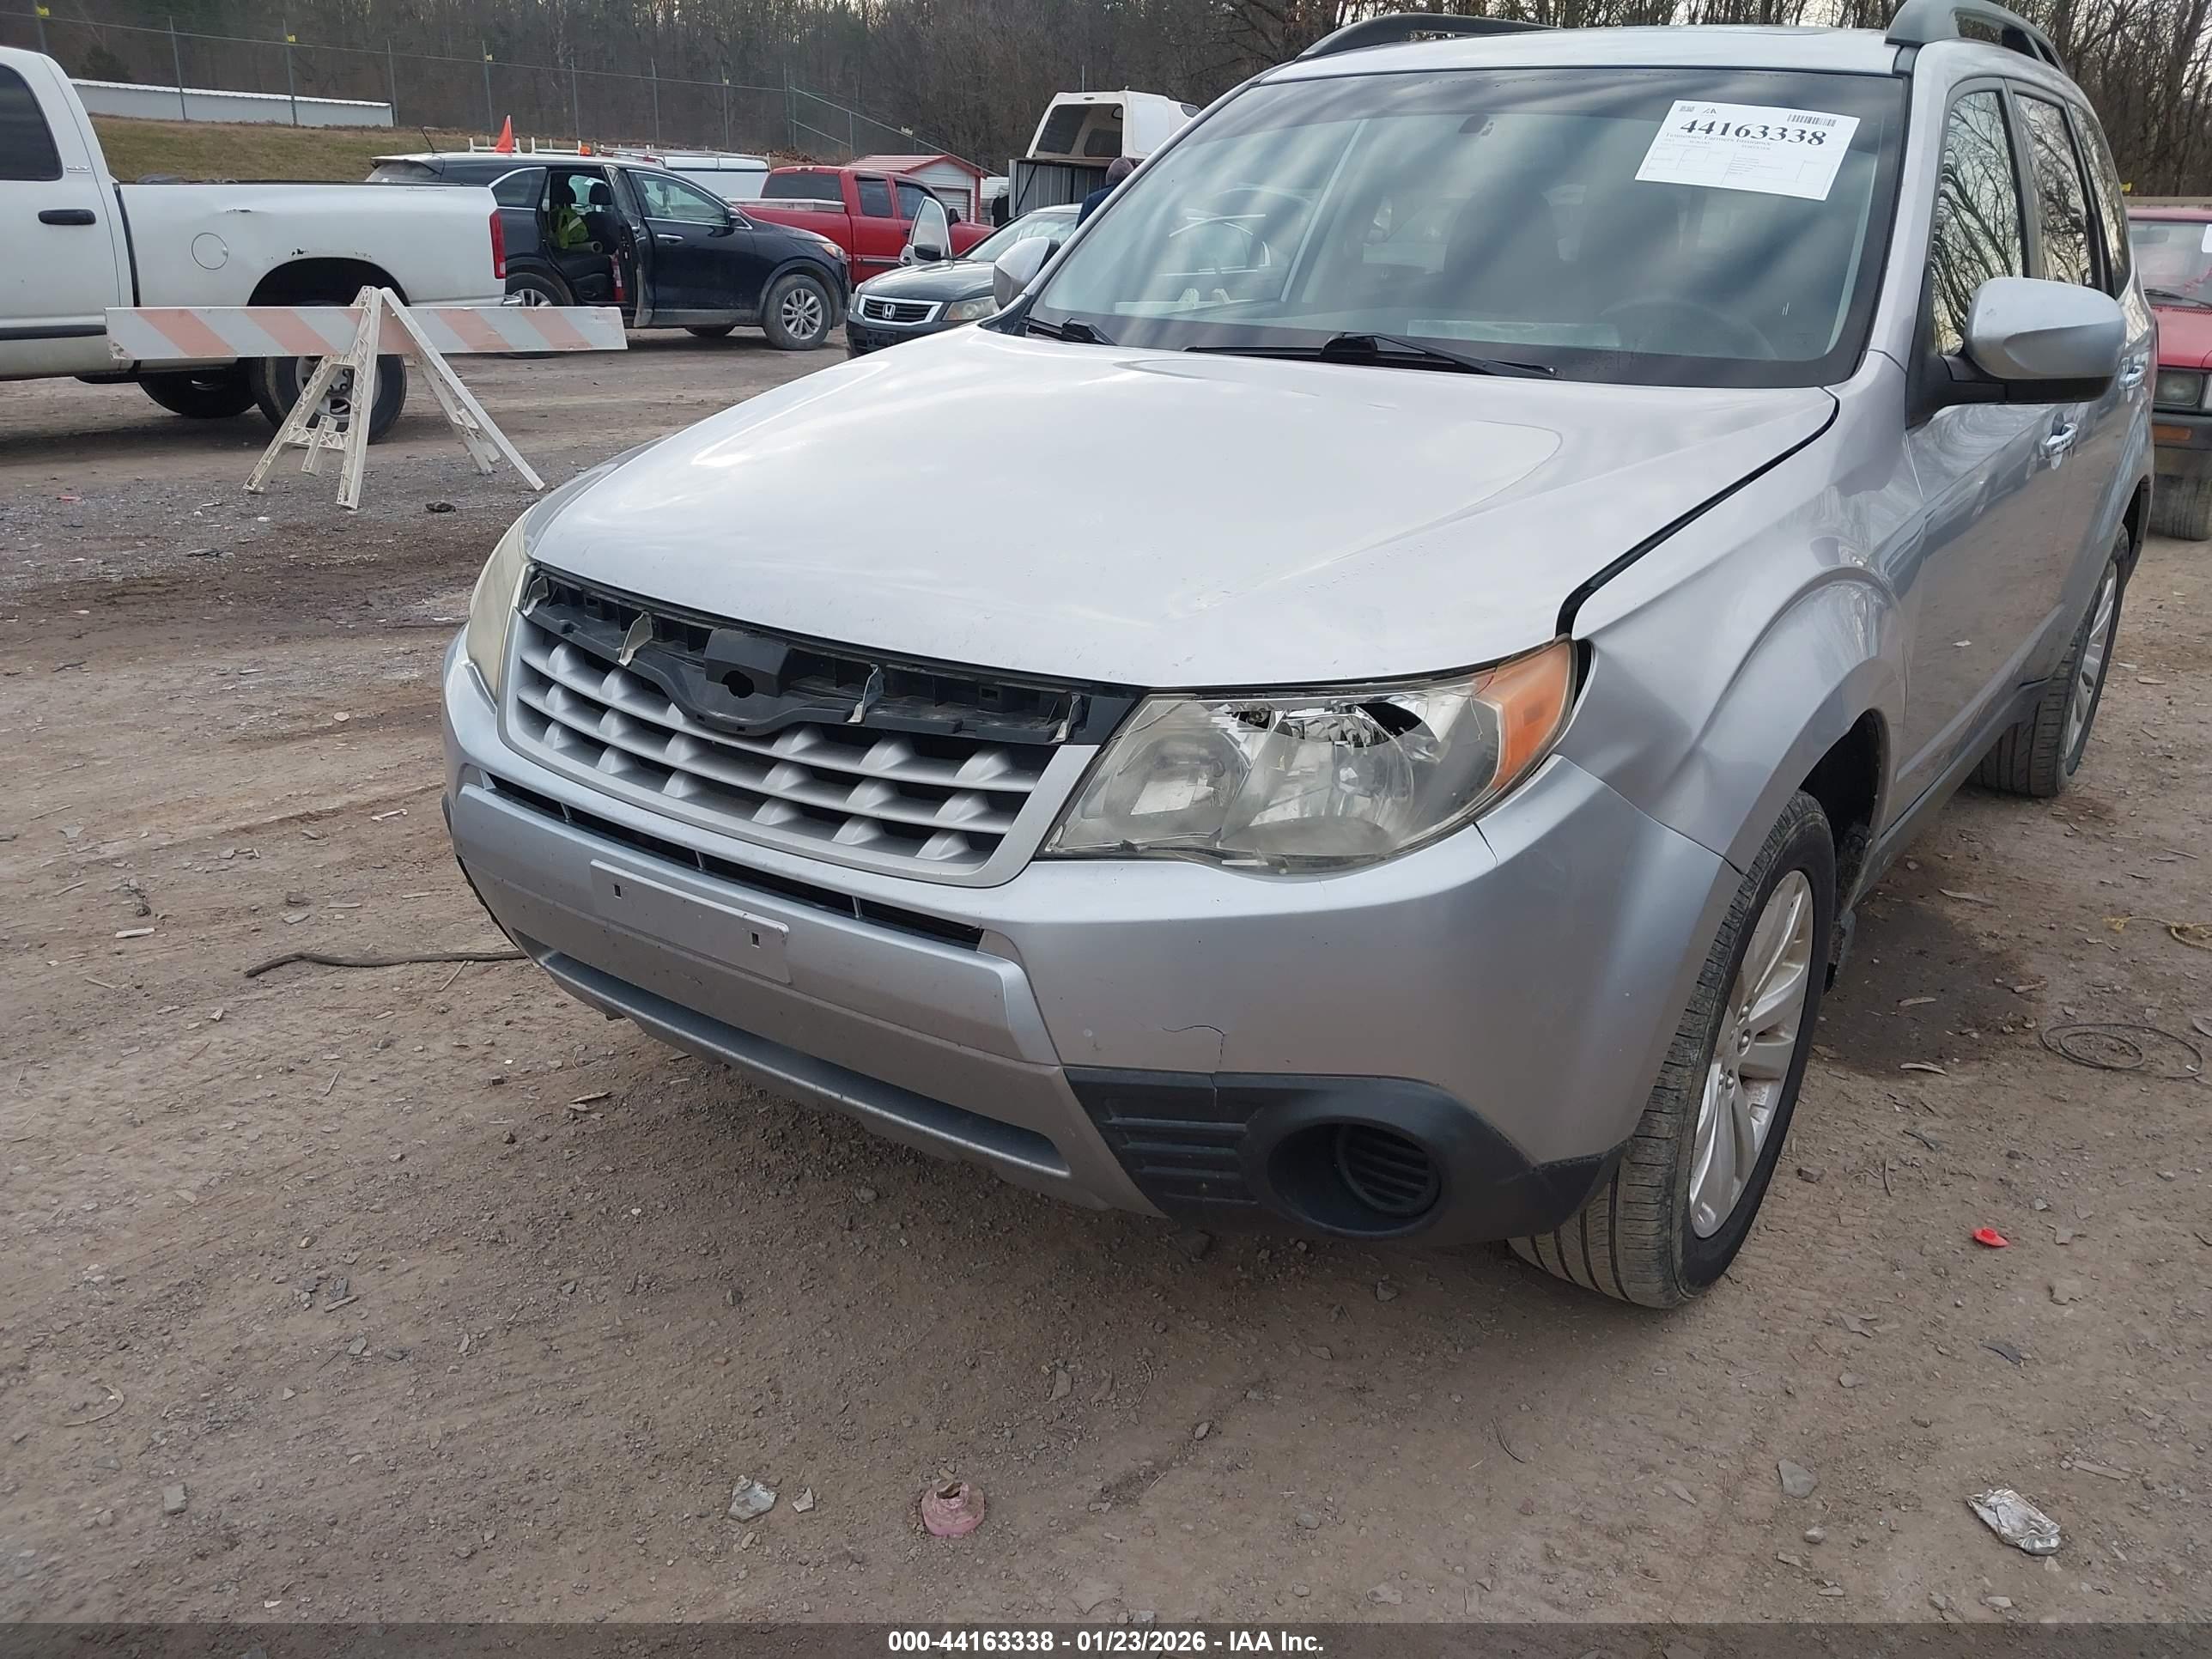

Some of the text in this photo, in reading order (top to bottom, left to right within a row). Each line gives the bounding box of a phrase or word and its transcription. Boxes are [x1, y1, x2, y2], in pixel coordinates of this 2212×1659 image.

[1666, 132, 1702, 141] Tennessee
[1704, 134, 1735, 143] Farmers
[1680, 118, 1827, 146] 44163338
